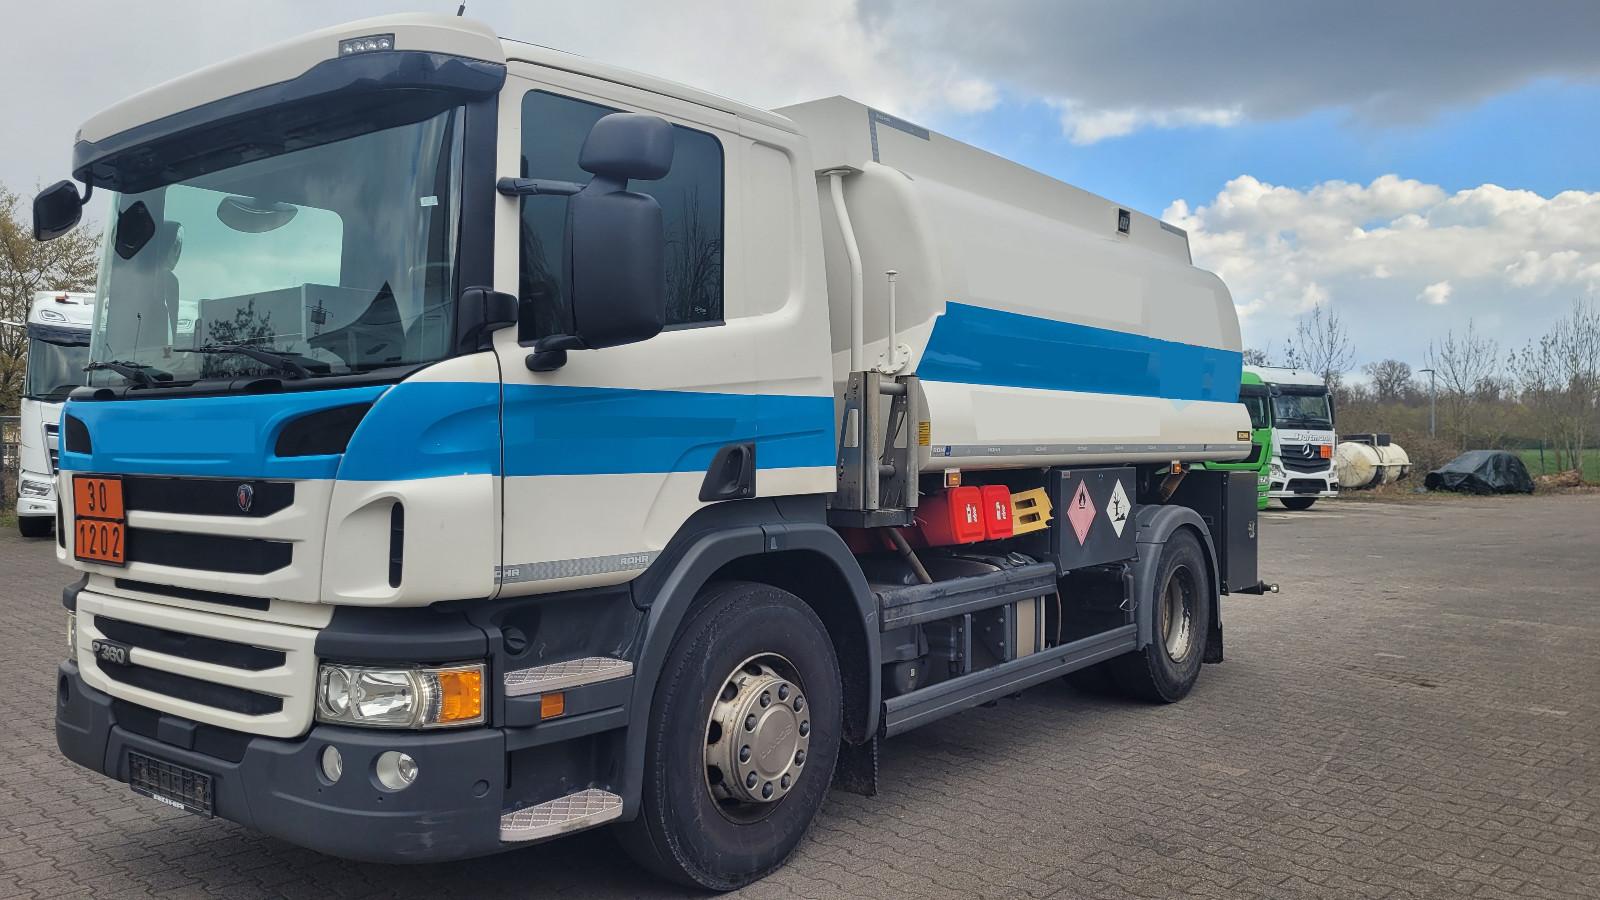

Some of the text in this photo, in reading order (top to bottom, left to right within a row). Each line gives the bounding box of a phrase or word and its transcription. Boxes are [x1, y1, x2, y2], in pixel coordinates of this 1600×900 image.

[88, 481, 107, 512] 30
[80, 524, 120, 557] 1202
[101, 644, 125, 664] 360
